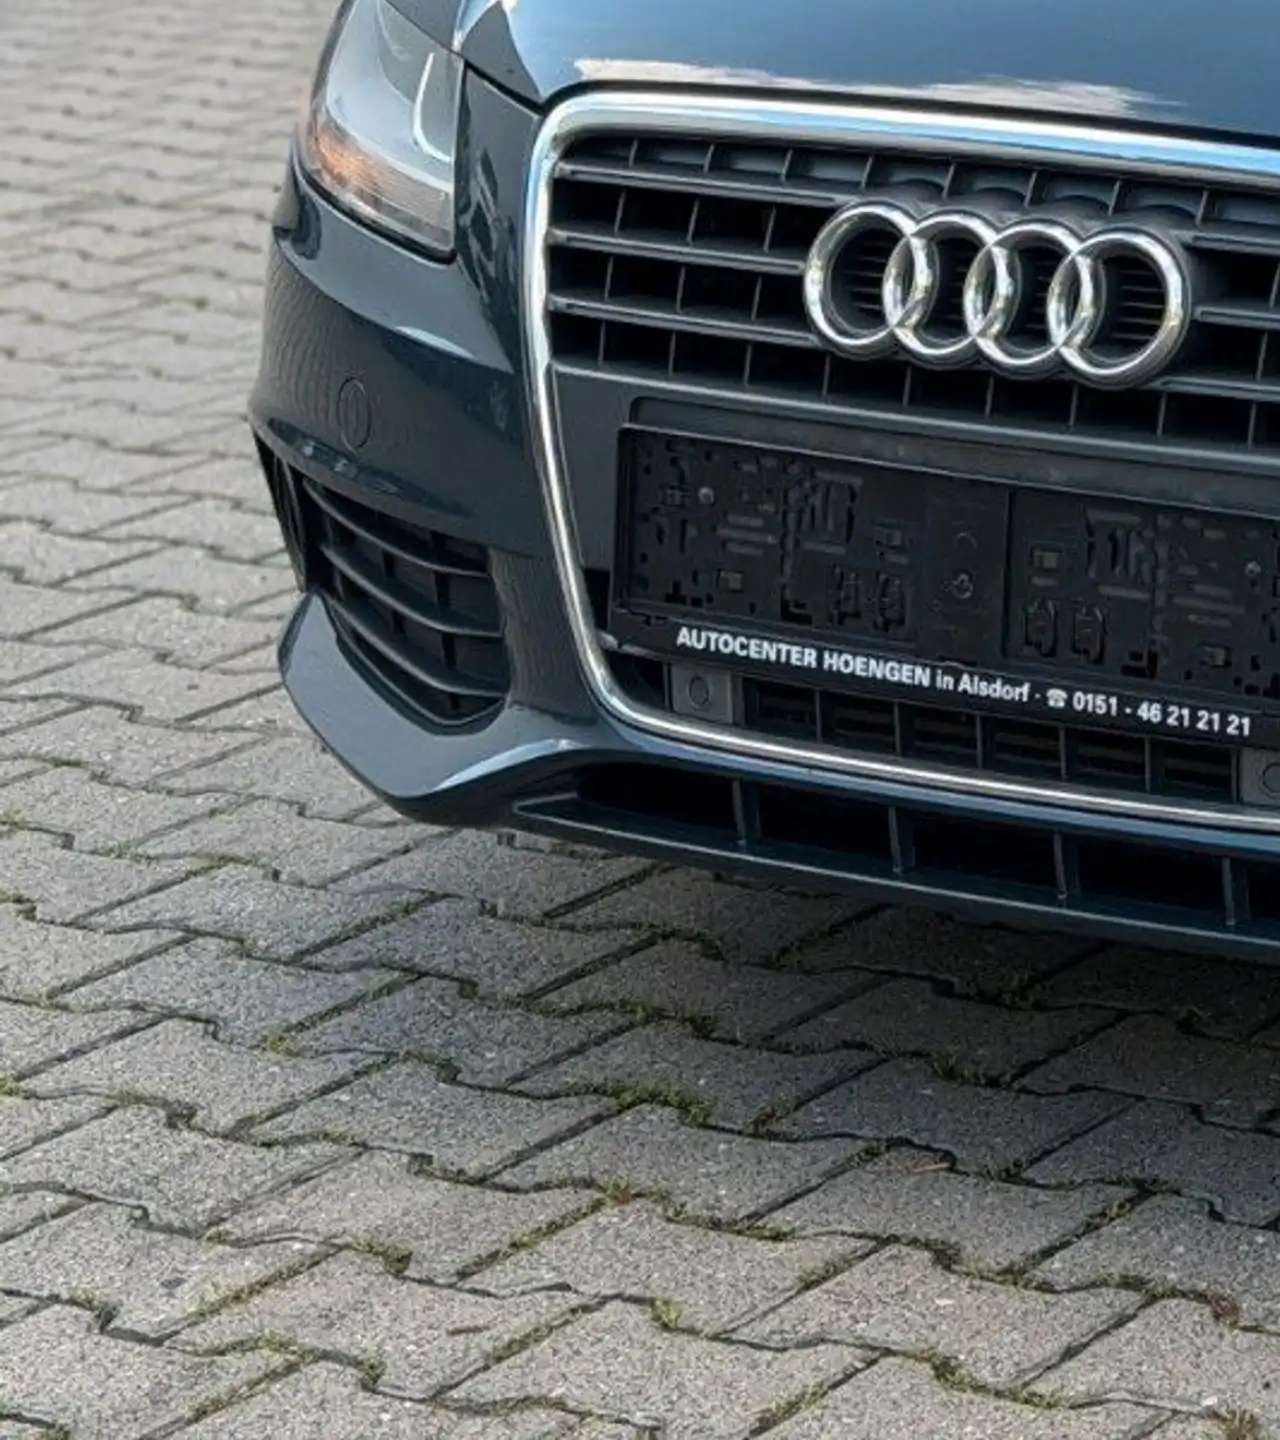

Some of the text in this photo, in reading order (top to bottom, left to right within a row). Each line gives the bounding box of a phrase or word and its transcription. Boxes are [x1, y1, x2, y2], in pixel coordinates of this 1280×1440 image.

[676, 626, 817, 669] AUTOCENTER
[822, 650, 930, 688] HOENGEN
[935, 669, 955, 692] in
[957, 672, 1030, 702] Alsdorf
[1072, 691, 1119, 717] 0151
[1136, 701, 1162, 723] 46
[1167, 705, 1190, 728] 21
[1195, 710, 1220, 733] 21
[1226, 714, 1250, 737] 21
